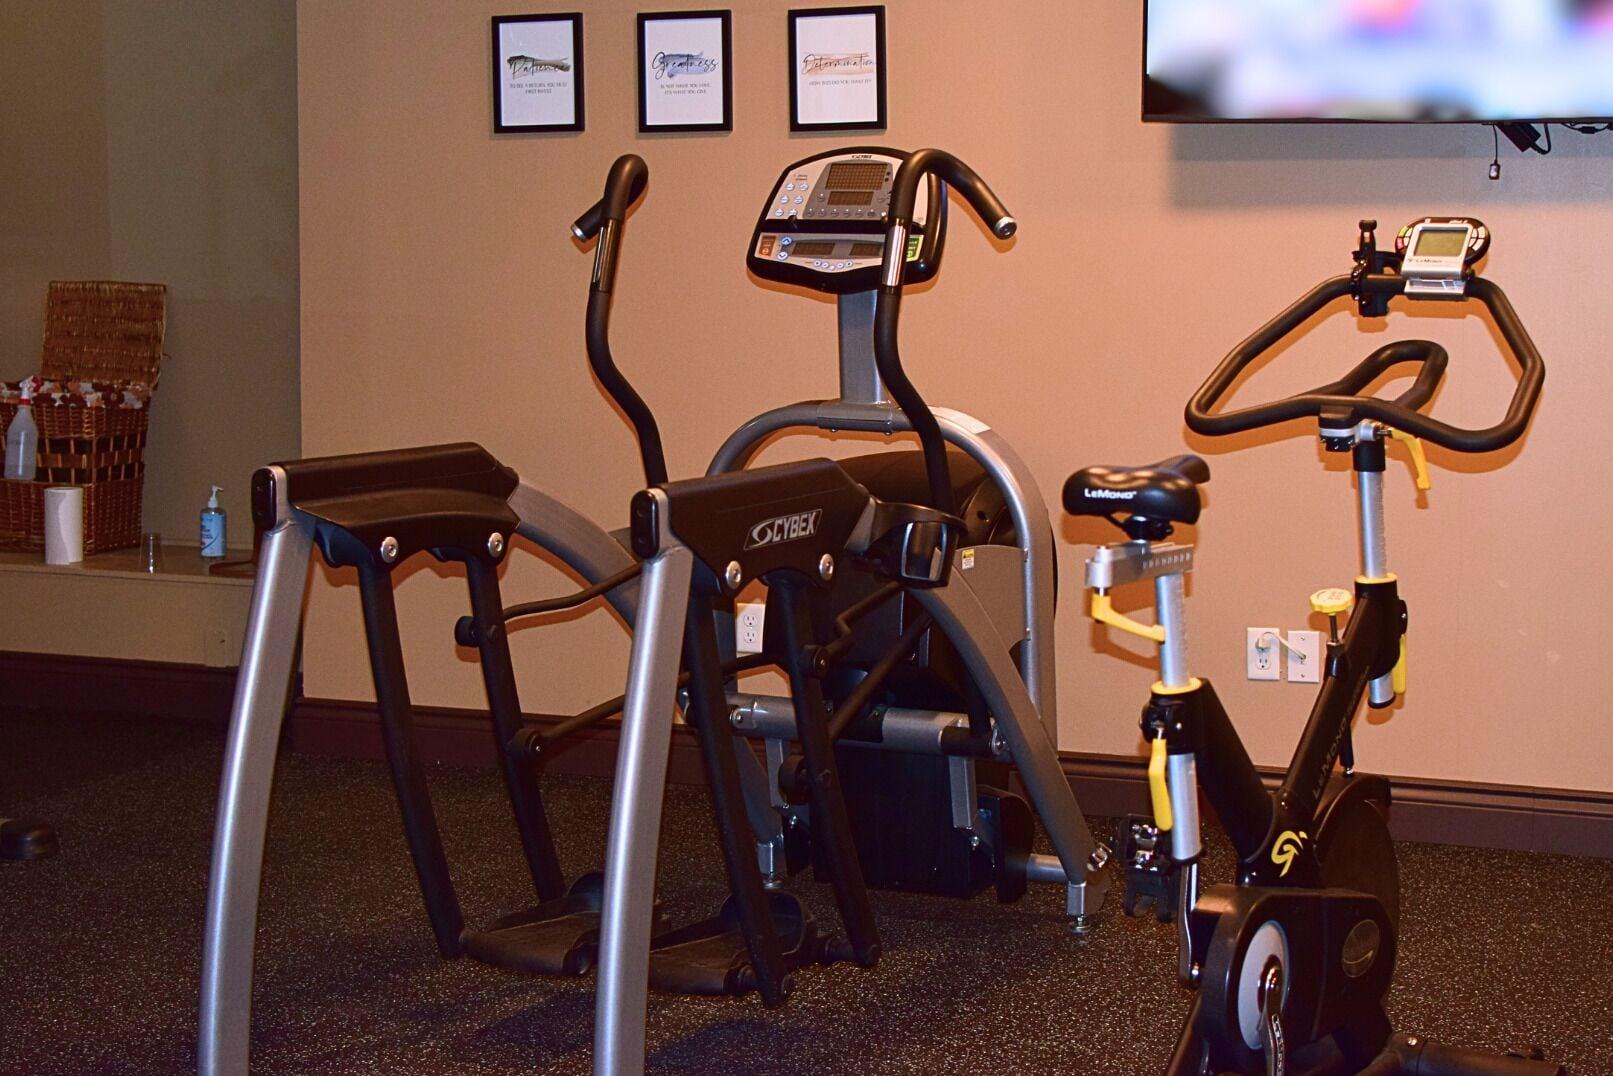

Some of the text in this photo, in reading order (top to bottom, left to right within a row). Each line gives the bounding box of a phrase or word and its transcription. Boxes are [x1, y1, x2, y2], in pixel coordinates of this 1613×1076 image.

[652, 51, 718, 80] Greatness
[801, 53, 874, 75] Determination
[771, 511, 817, 543] CYBEX
